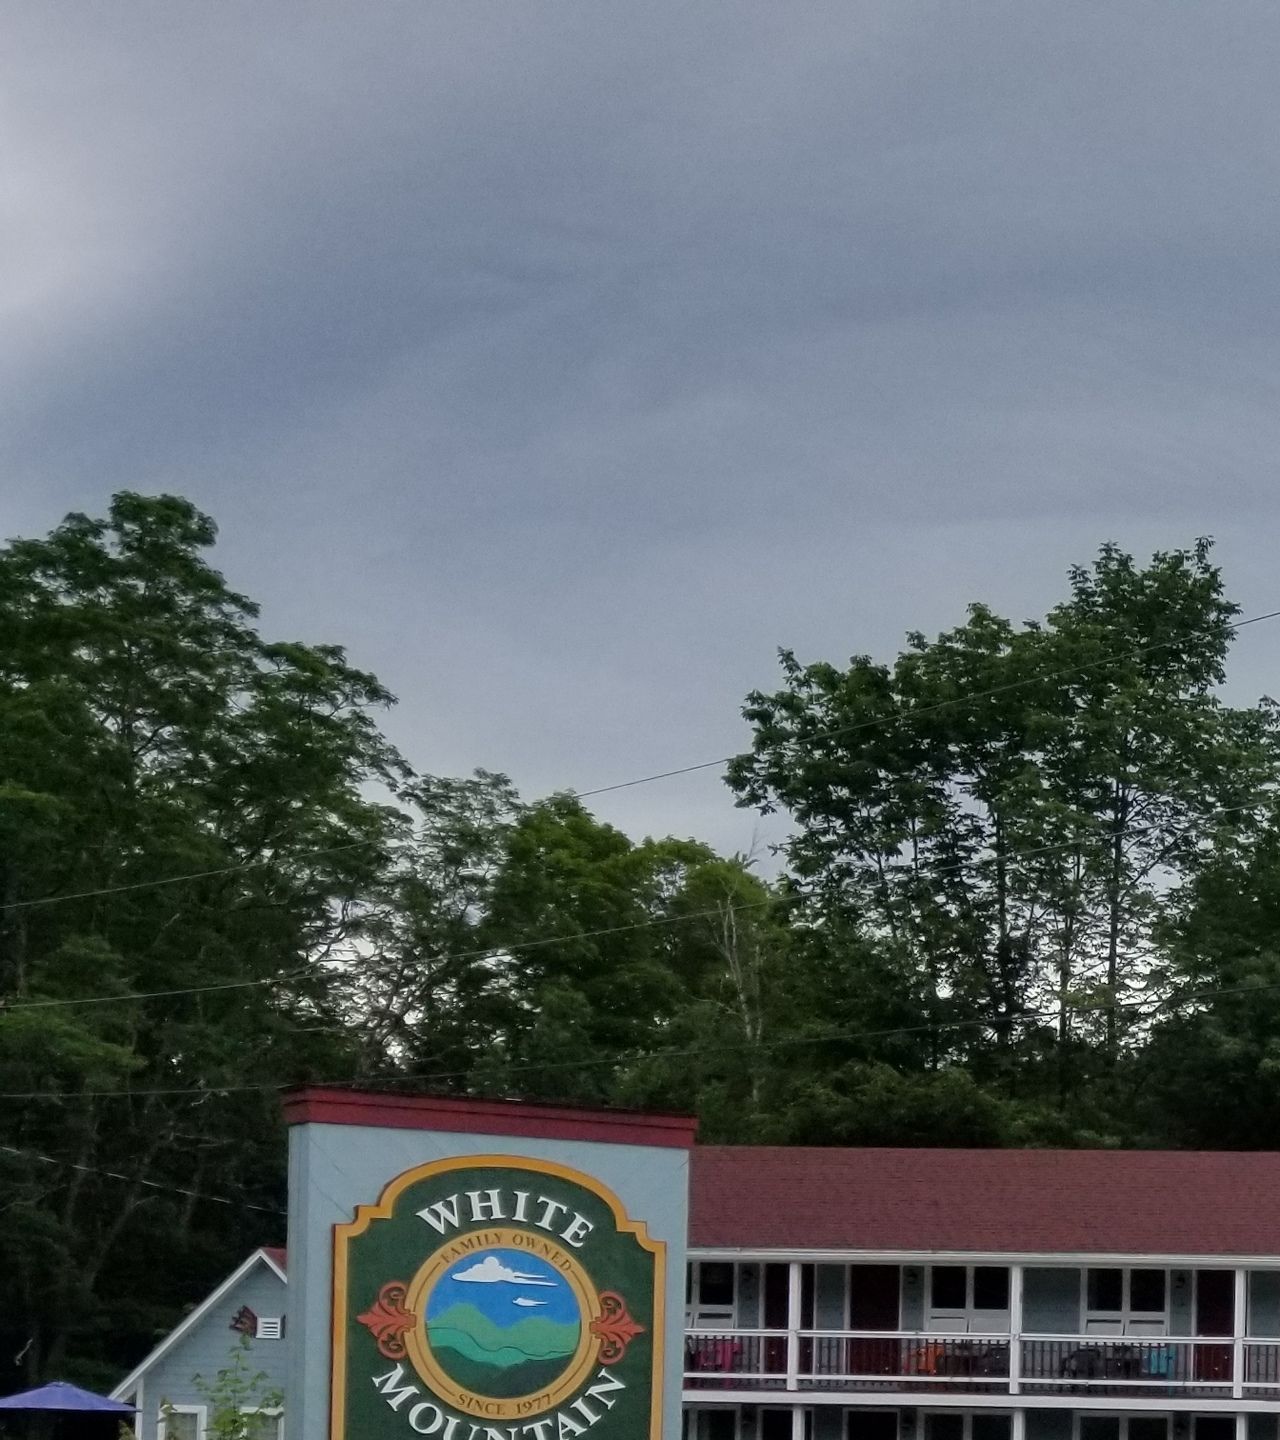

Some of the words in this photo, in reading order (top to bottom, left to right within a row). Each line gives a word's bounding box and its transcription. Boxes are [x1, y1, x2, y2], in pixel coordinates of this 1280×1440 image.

[415, 1189, 594, 1247] WHITE
[440, 1232, 503, 1263] FAMILY
[512, 1234, 572, 1272] OWNED
[457, 1393, 505, 1415] SINCE
[516, 1394, 552, 1415] 1977
